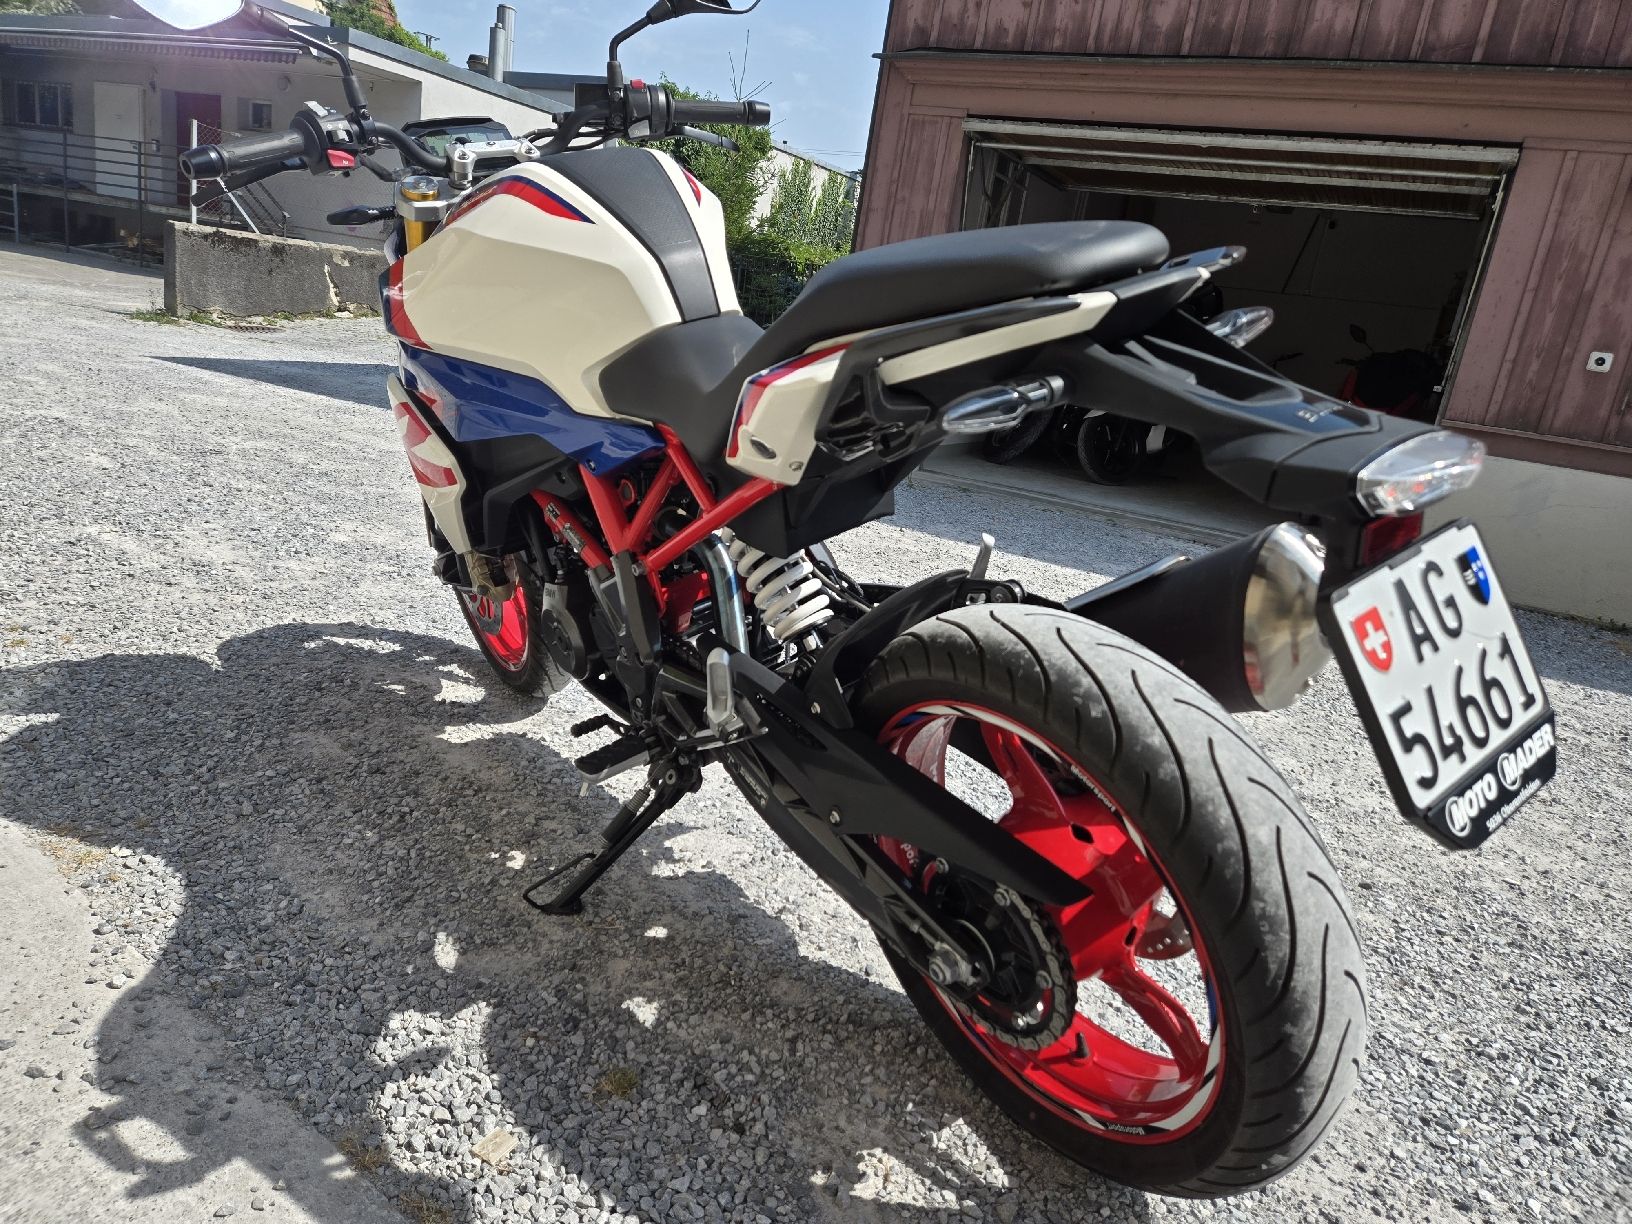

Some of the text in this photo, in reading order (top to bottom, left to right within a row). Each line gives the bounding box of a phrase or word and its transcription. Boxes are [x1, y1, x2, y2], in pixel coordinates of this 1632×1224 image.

[1393, 559, 1463, 664] AG
[1388, 632, 1536, 790] 54661
[1071, 764, 1116, 812] Motorsport
[1445, 723, 1555, 837] MOTO MADER
